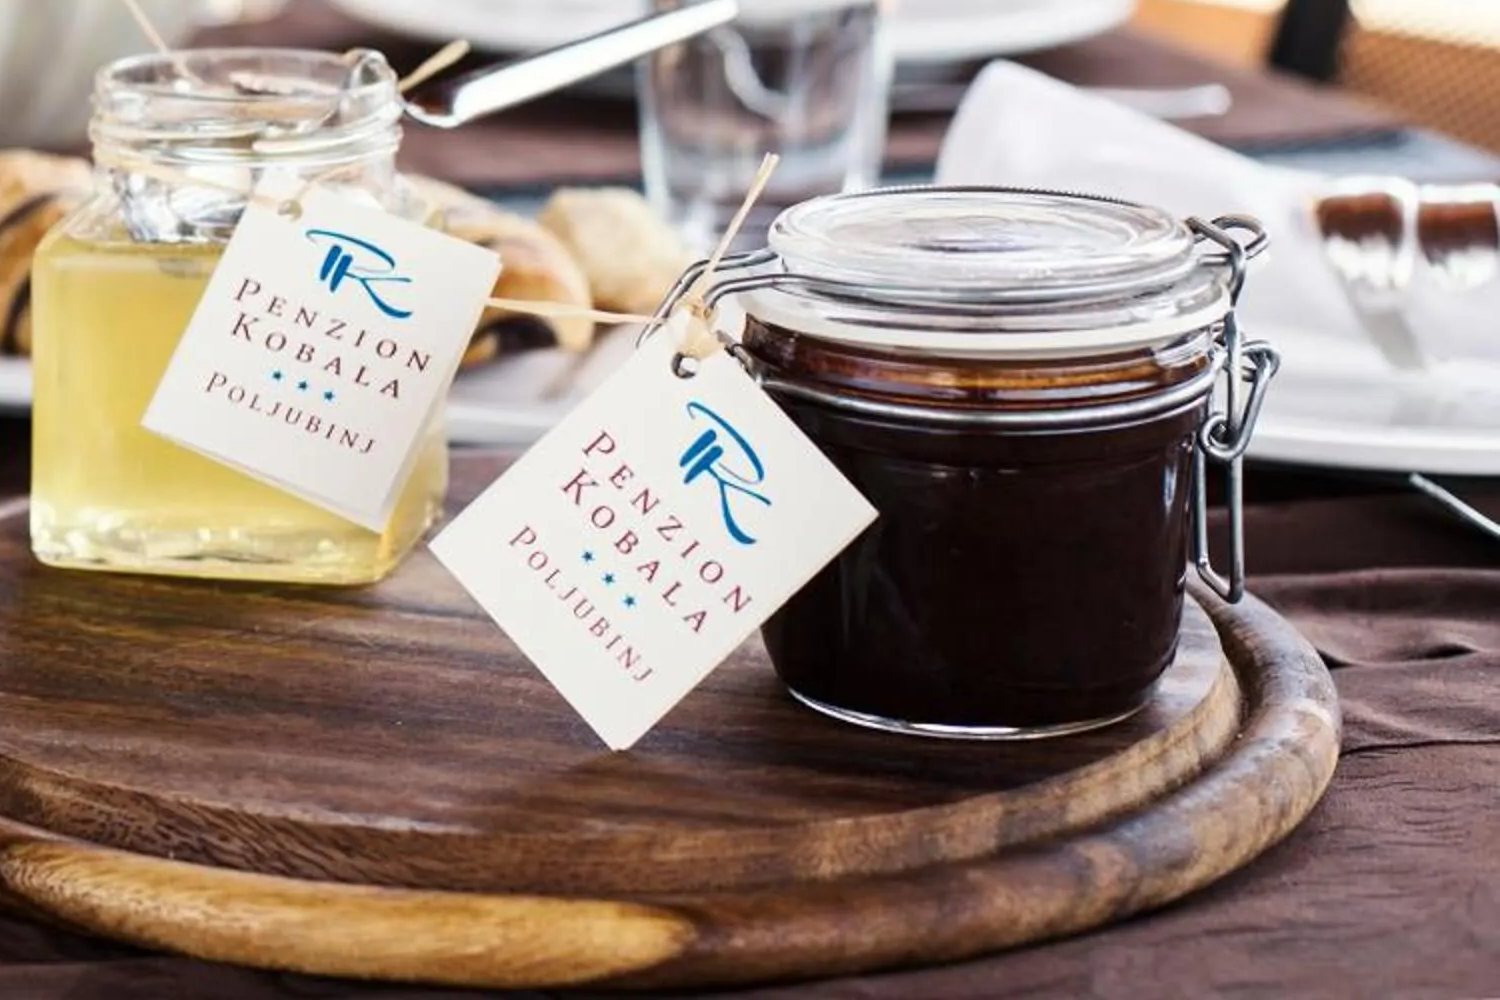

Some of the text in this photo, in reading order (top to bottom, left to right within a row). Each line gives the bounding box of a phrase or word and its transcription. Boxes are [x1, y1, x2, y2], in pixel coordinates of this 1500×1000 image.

[231, 313, 400, 400] KOBALA
[235, 279, 432, 373] PENZION
[206, 372, 376, 455] POLJUBINJ
[562, 468, 708, 634] KOBALA
[582, 431, 753, 613] PENZION
[509, 526, 653, 682] POLJUBINJ
